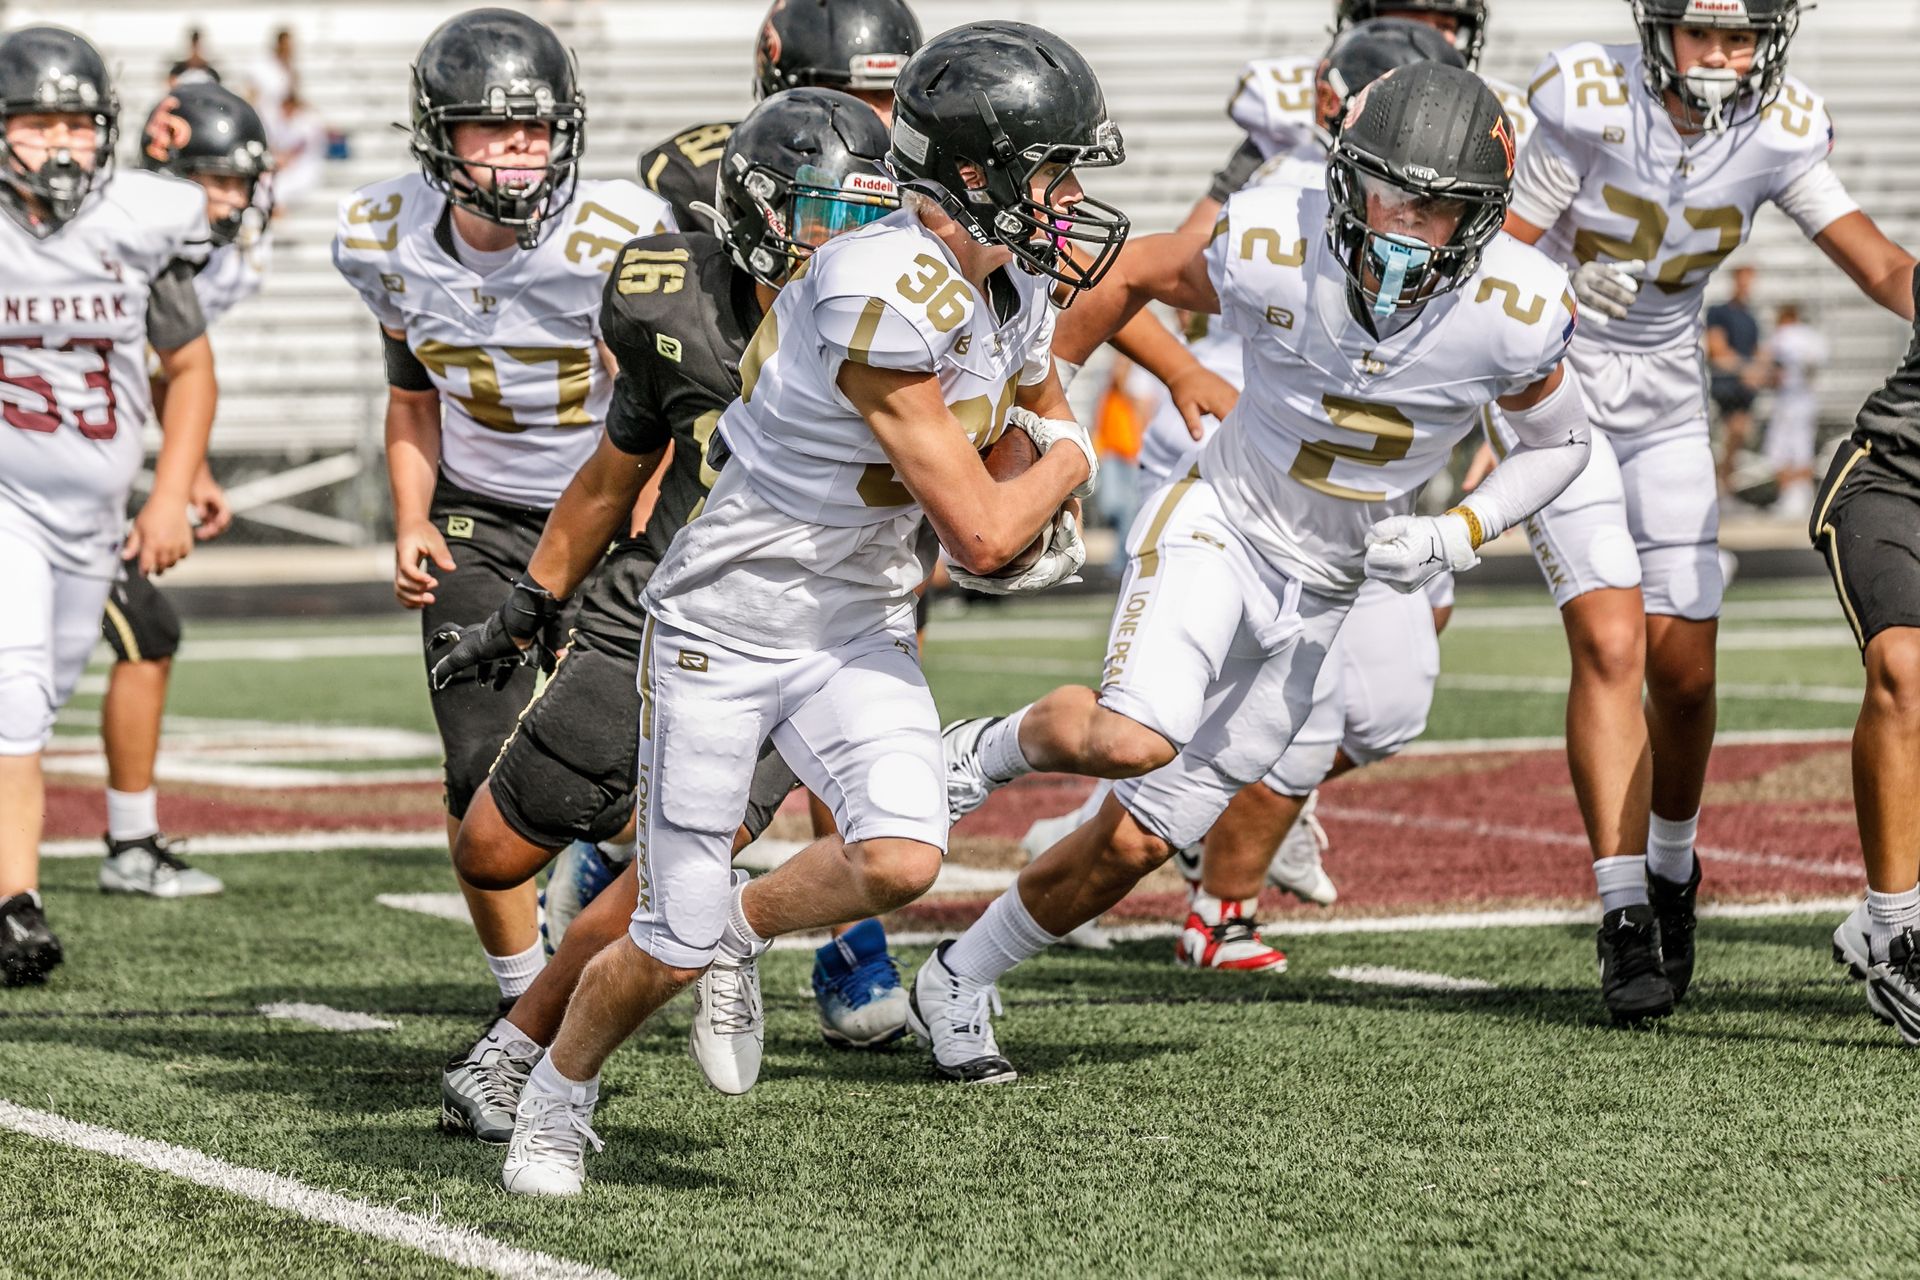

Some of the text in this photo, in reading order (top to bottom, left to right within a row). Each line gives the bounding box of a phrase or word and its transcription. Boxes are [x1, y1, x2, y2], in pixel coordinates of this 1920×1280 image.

[1695, 1, 1738, 11] Riddell
[1574, 57, 1629, 108] 22
[1760, 84, 1815, 137] 22
[853, 177, 893, 193] Riddell
[1408, 166, 1433, 181] VICIS
[345, 192, 404, 251] 37
[564, 201, 640, 273] 37
[1572, 183, 1744, 296] 22
[617, 247, 690, 295] 16
[1240, 227, 1308, 268] 2
[5, 292, 127, 323] NE PEAK
[895, 253, 975, 333] 36
[1474, 276, 1547, 325] 2
[0, 336, 118, 440] 53
[415, 338, 594, 433] 37
[1287, 393, 1416, 503] 2
[1536, 542, 1568, 593] PEAK
[1116, 590, 1150, 638] LONE
[637, 762, 651, 914] LONE PEAK
